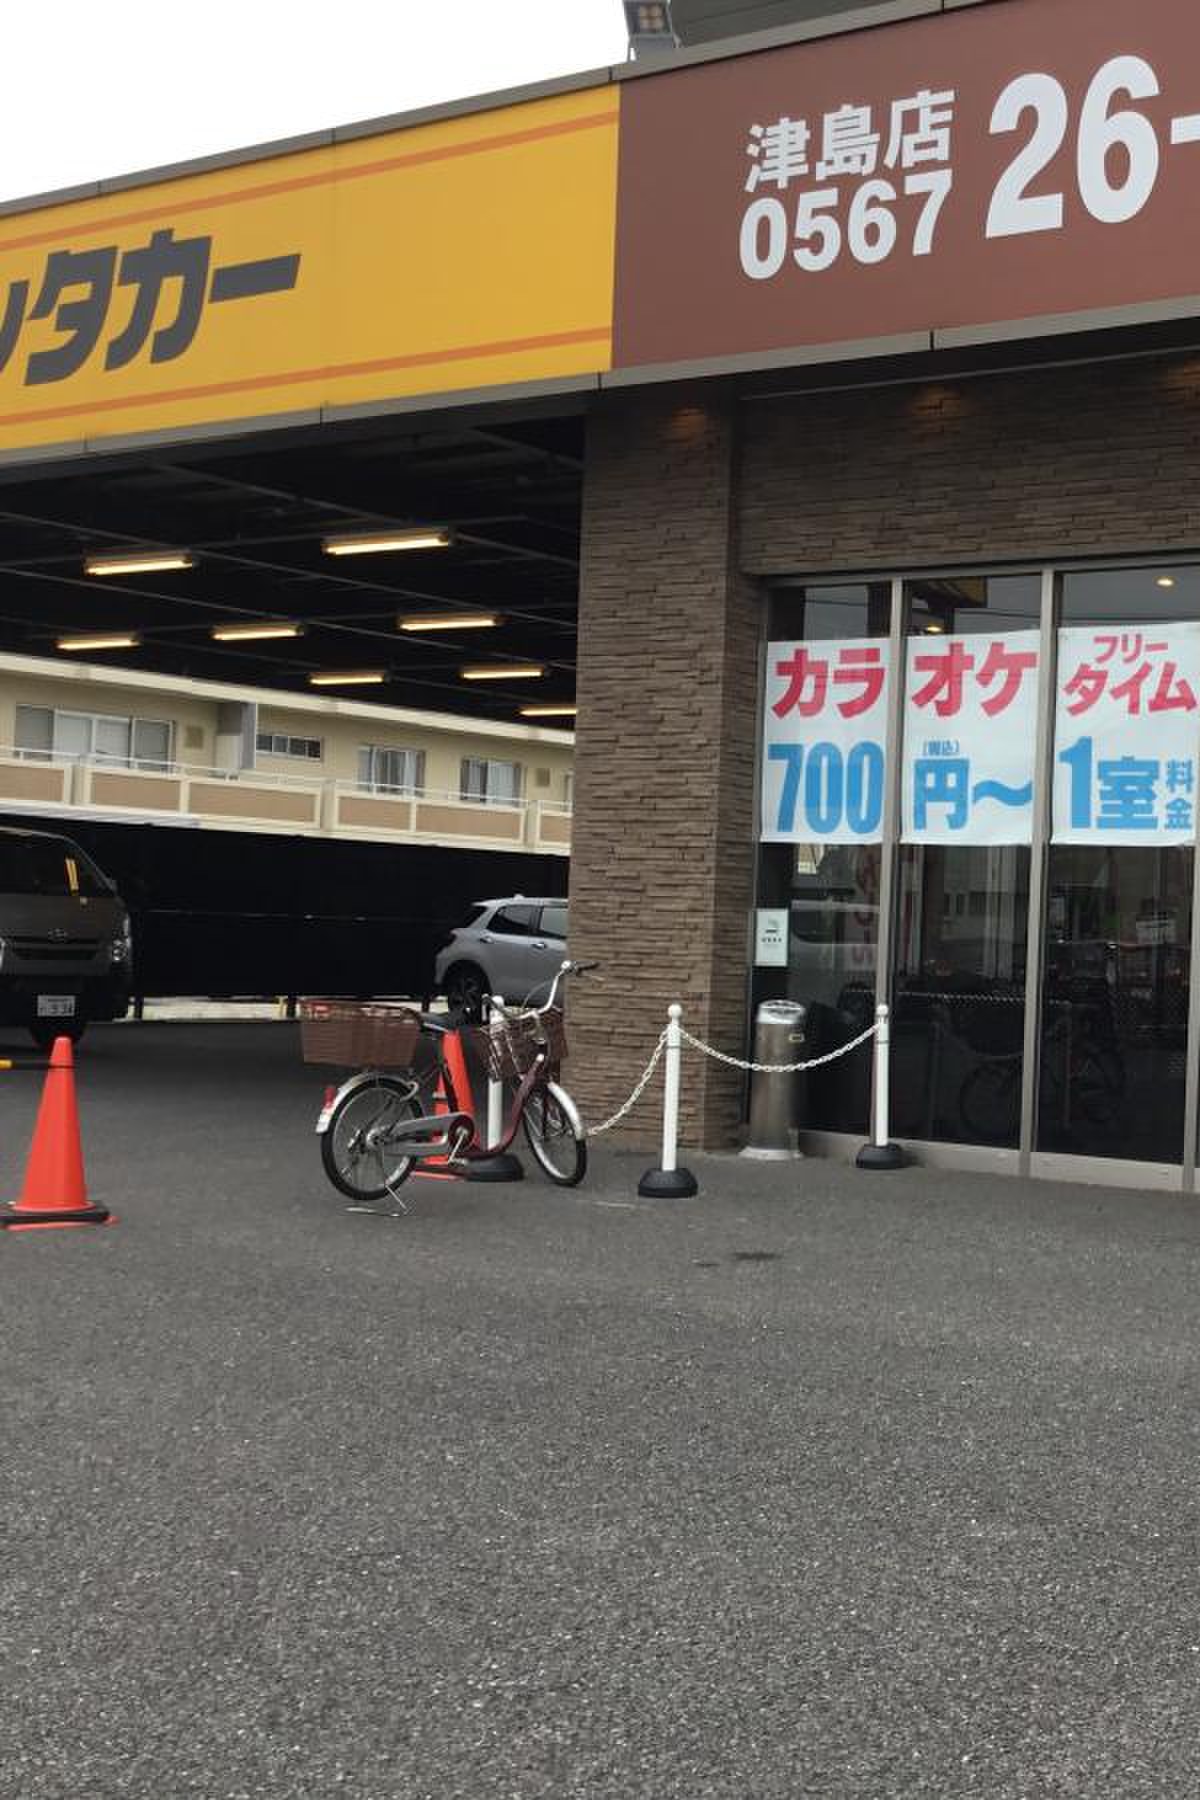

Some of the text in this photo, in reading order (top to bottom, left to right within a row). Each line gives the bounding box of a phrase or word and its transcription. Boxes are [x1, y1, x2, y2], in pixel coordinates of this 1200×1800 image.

[744, 89, 956, 193] 津島店
[738, 170, 954, 280] 0567
[1063, 660, 1198, 718] タイム
[1093, 634, 1169, 664] フリー
